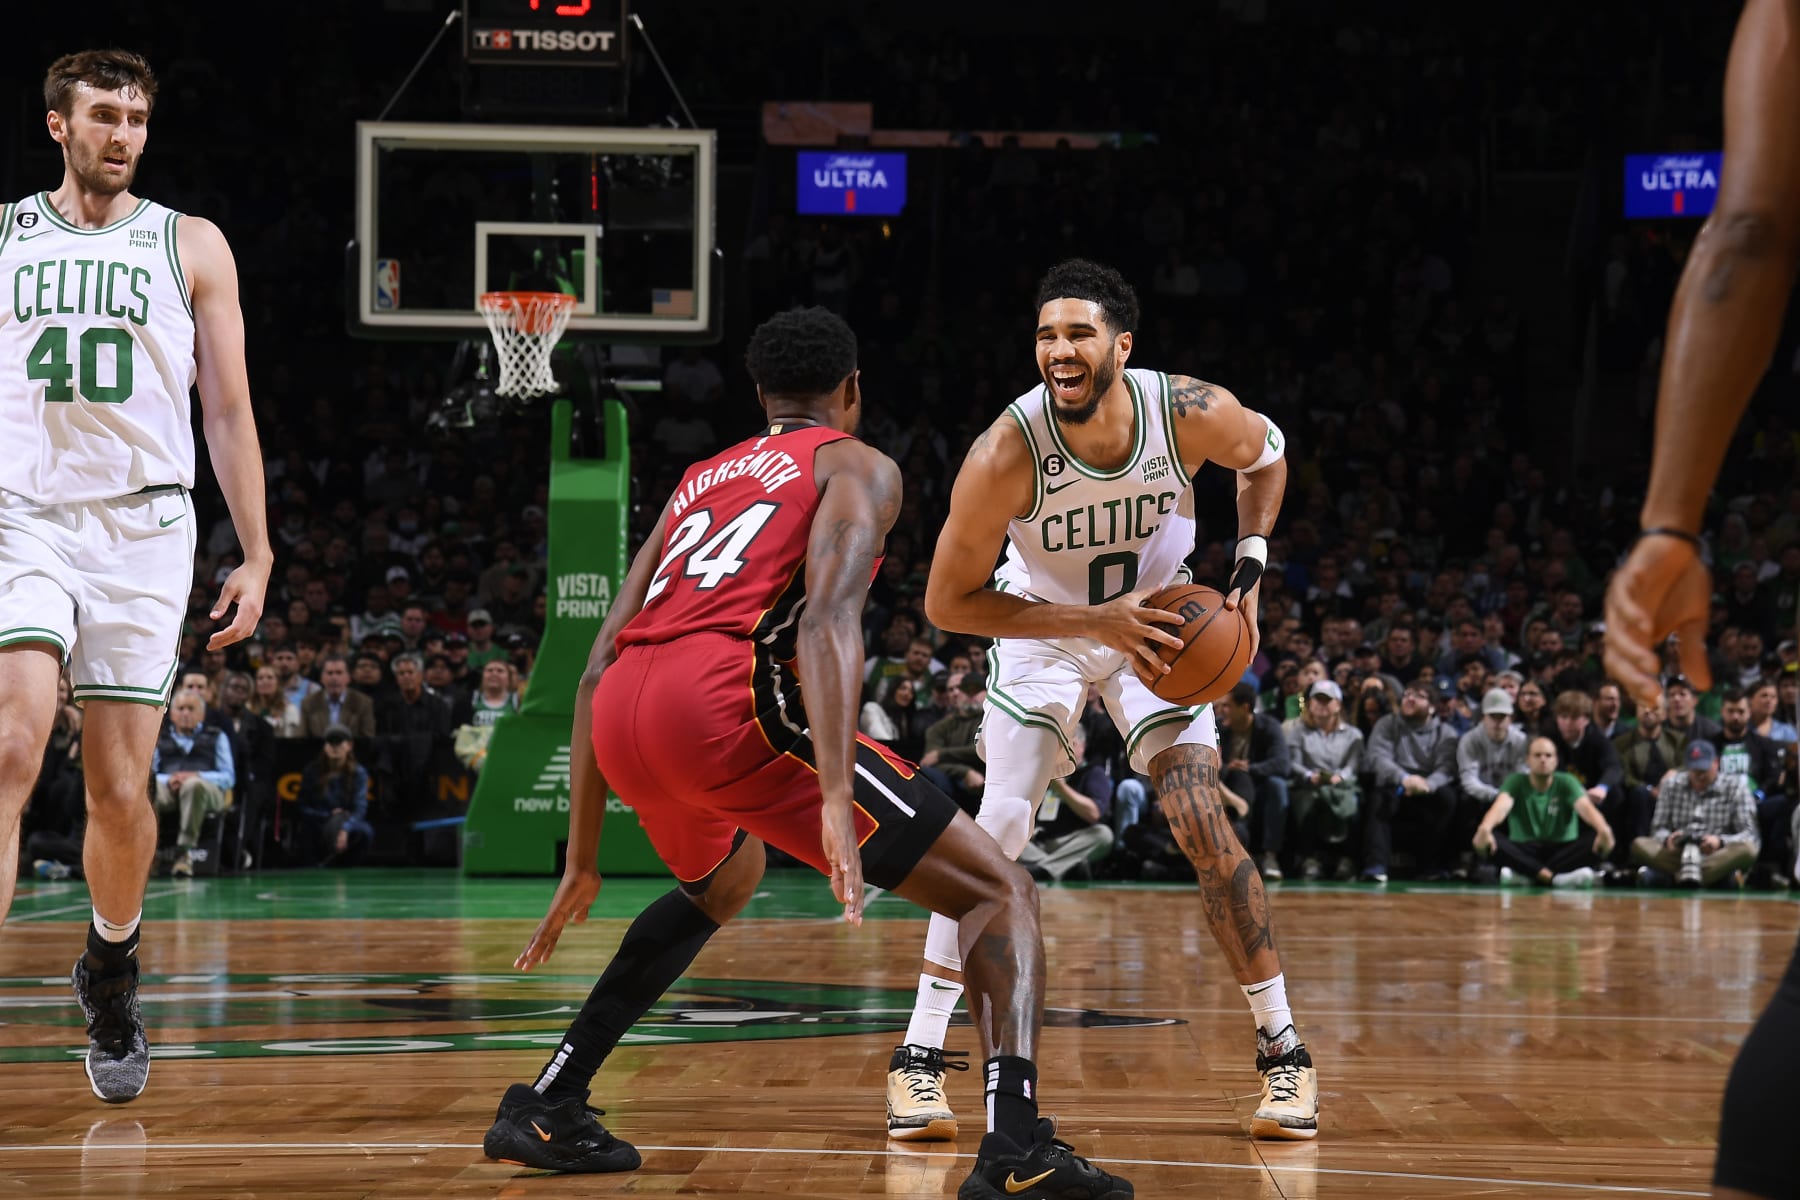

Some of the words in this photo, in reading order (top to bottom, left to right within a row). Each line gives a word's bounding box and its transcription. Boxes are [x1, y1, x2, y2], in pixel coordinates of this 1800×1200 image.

[513, 30, 615, 50] TISSOT
[814, 169, 888, 188] ULTRA
[1642, 169, 1717, 190] ULTRA
[129, 229, 158, 241] VISTA
[129, 240, 157, 249] PRINT
[14, 259, 152, 326] CELTICS
[26, 327, 133, 404] 40
[1047, 457, 1061, 475] 6
[1141, 456, 1169, 474] VISTA
[673, 450, 802, 517] HIGHSMITH
[1143, 467, 1169, 483] PRINT
[642, 500, 782, 610] 24
[556, 573, 610, 599] VISTA
[1088, 551, 1139, 606] 0
[556, 601, 609, 618] PRINT
[514, 798, 554, 812] new
